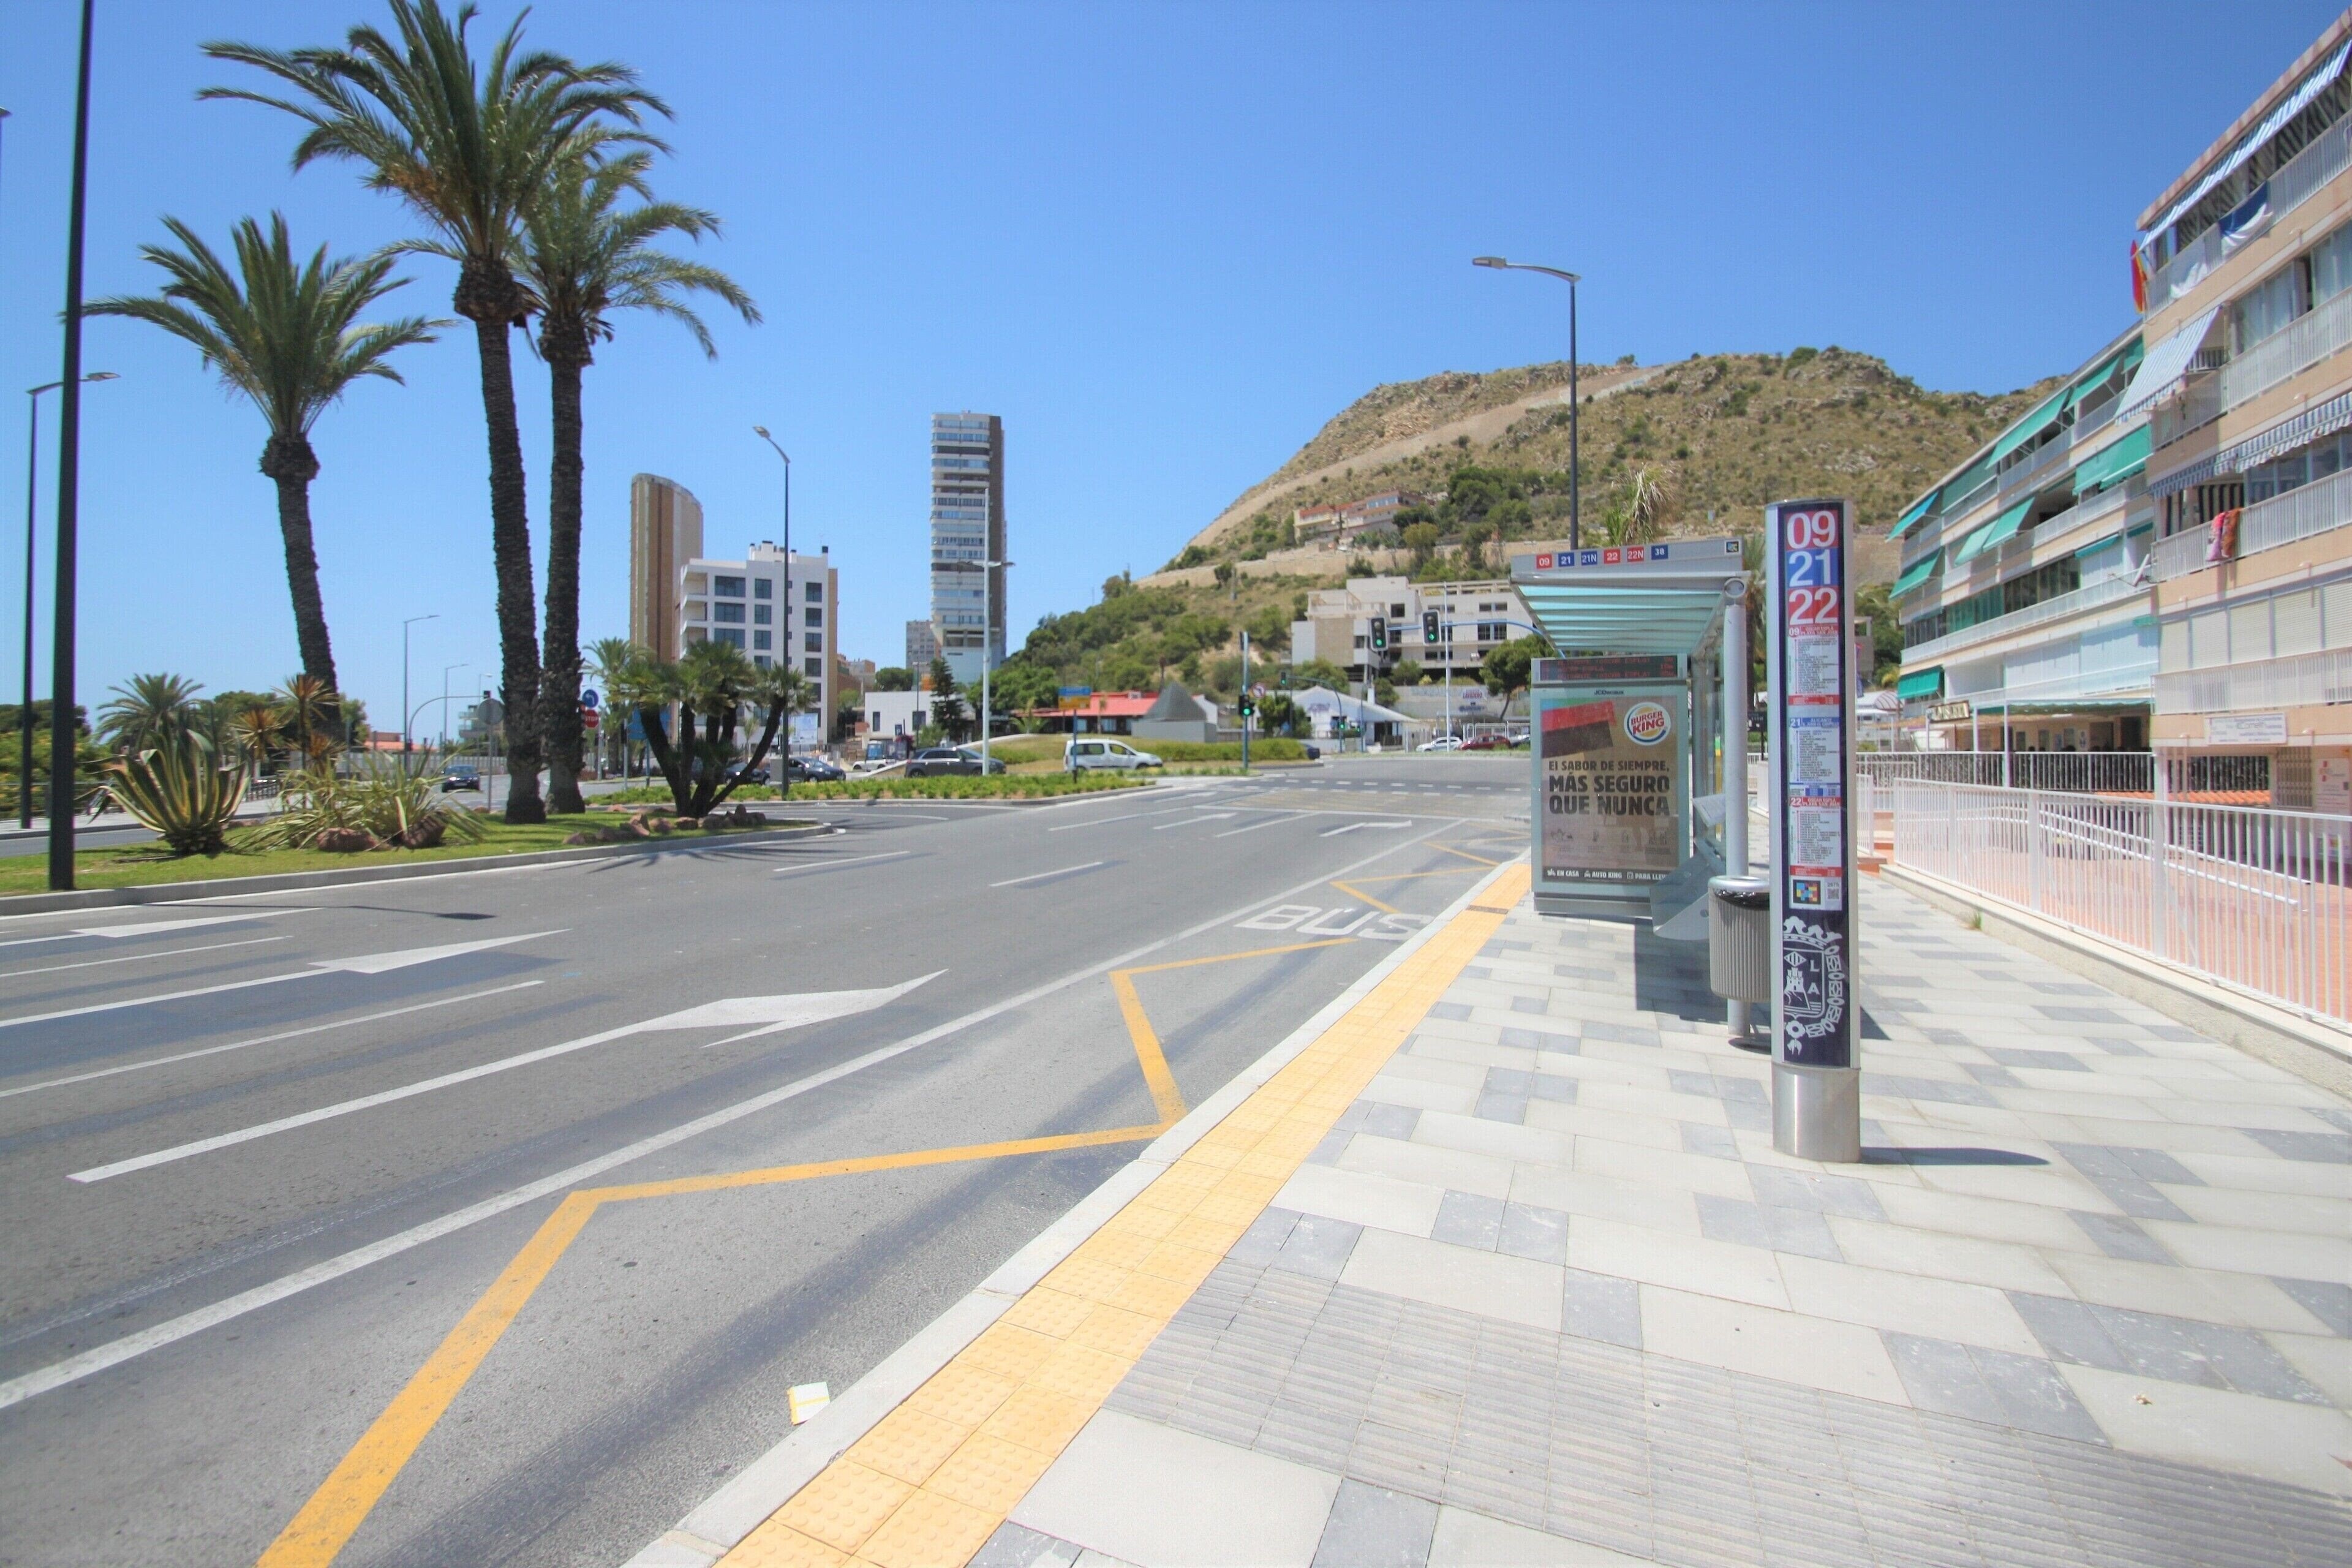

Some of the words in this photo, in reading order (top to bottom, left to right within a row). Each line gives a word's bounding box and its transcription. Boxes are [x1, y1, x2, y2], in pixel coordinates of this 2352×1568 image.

[1787, 510, 1836, 549] 09
[1581, 554, 1597, 563] 21N
[1607, 552, 1618, 561] 22
[1627, 550, 1644, 559] 22N
[1654, 548, 1665, 556] 38
[1561, 556, 1571, 565] 21
[1788, 549, 1831, 587] 21
[1789, 587, 1838, 625] 22
[1789, 627, 1800, 636] 09
[1630, 710, 1664, 726] BURGER
[1790, 718, 1801, 727] 21
[1632, 718, 1665, 735] KING
[1561, 761, 1597, 771] SABOR
[1600, 761, 1615, 771] DE
[1618, 761, 1670, 772] SIEMPRE,
[1549, 772, 1588, 793] MÁS
[1594, 775, 1670, 793] SEGURO
[1549, 795, 1590, 814] QUE
[1597, 796, 1670, 816] NUNCA
[1790, 797, 1801, 806] 22
[1233, 904, 1435, 940] BUS
[1811, 959, 1820, 972] L
[1807, 982, 1820, 995] A
